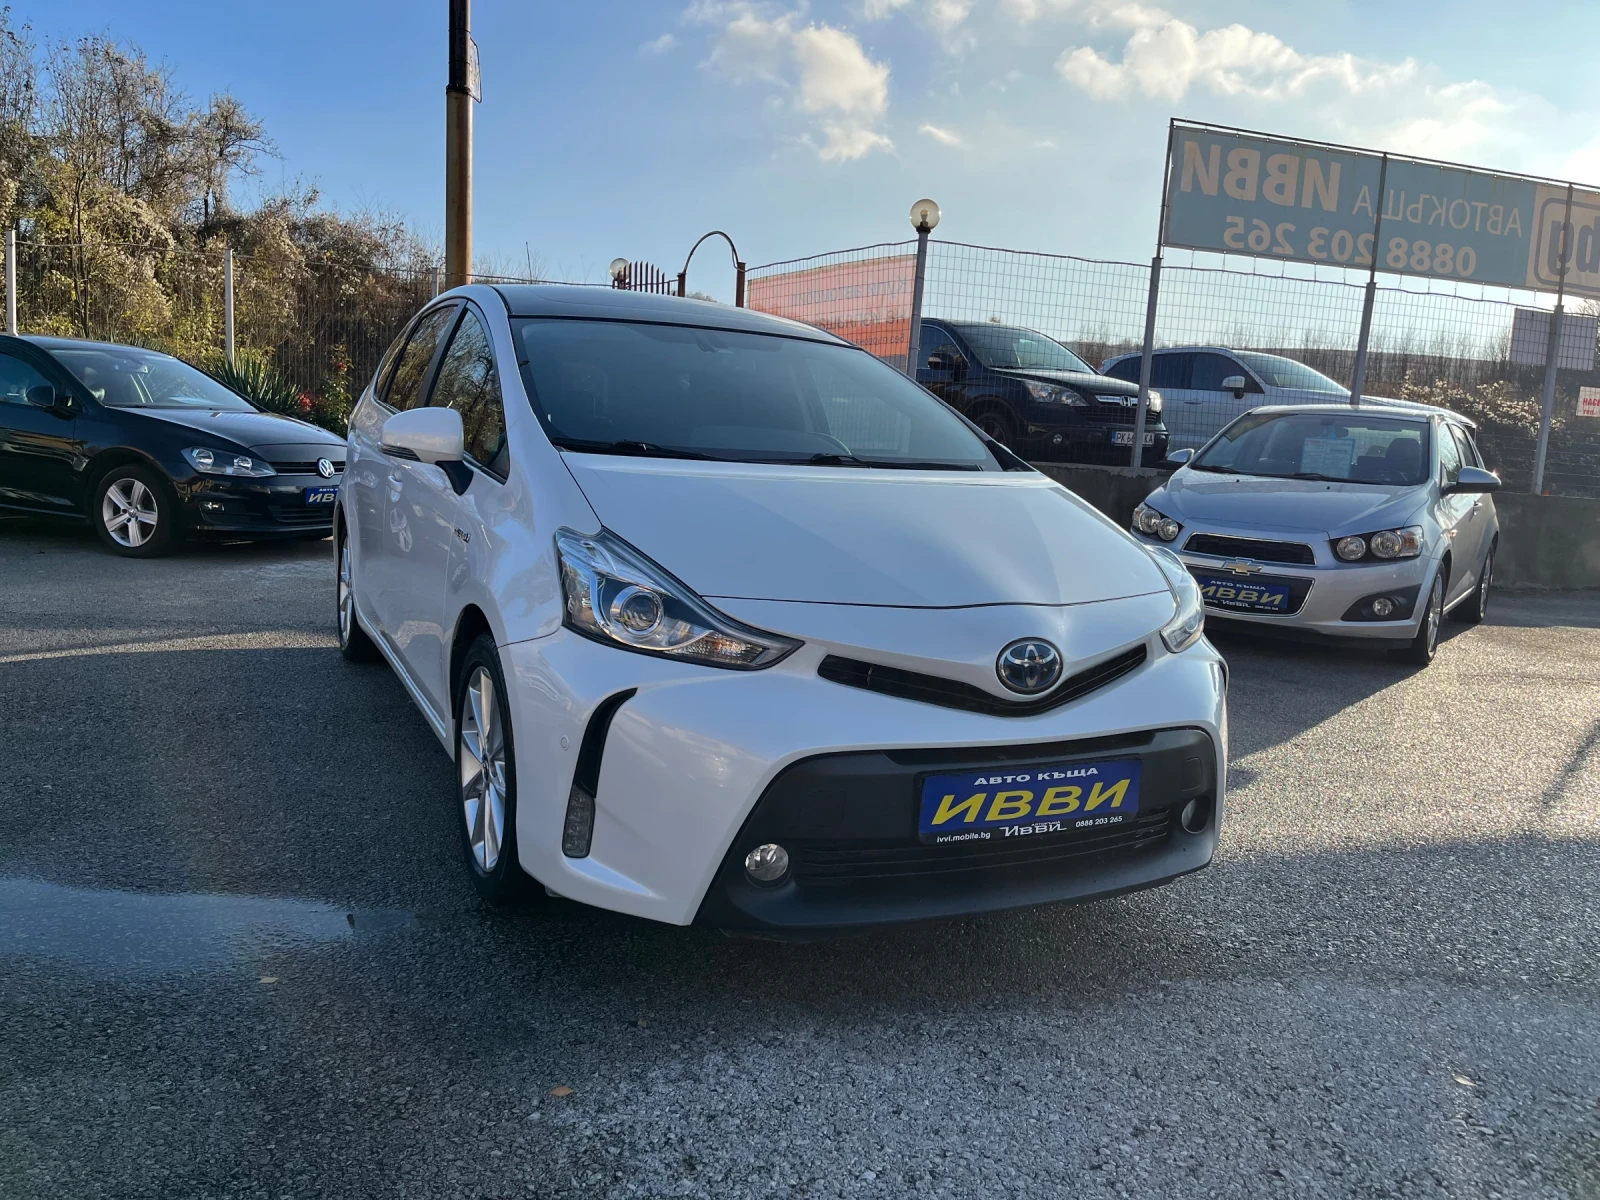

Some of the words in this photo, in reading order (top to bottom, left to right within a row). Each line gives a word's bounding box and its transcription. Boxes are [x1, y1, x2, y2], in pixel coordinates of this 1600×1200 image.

[308, 493, 336, 503] ИВ
[1236, 583, 1266, 591] КЪЩА
[1199, 584, 1284, 605] ИВВИ
[973, 774, 1031, 786] АВТО
[1037, 767, 1099, 781] КЪЩА
[931, 779, 1131, 825] ИВВИ
[1075, 819, 1094, 828] 0888
[1095, 817, 1108, 825] 203
[1109, 815, 1123, 823] 265
[936, 832, 991, 843] ivvi.mobile.bg
